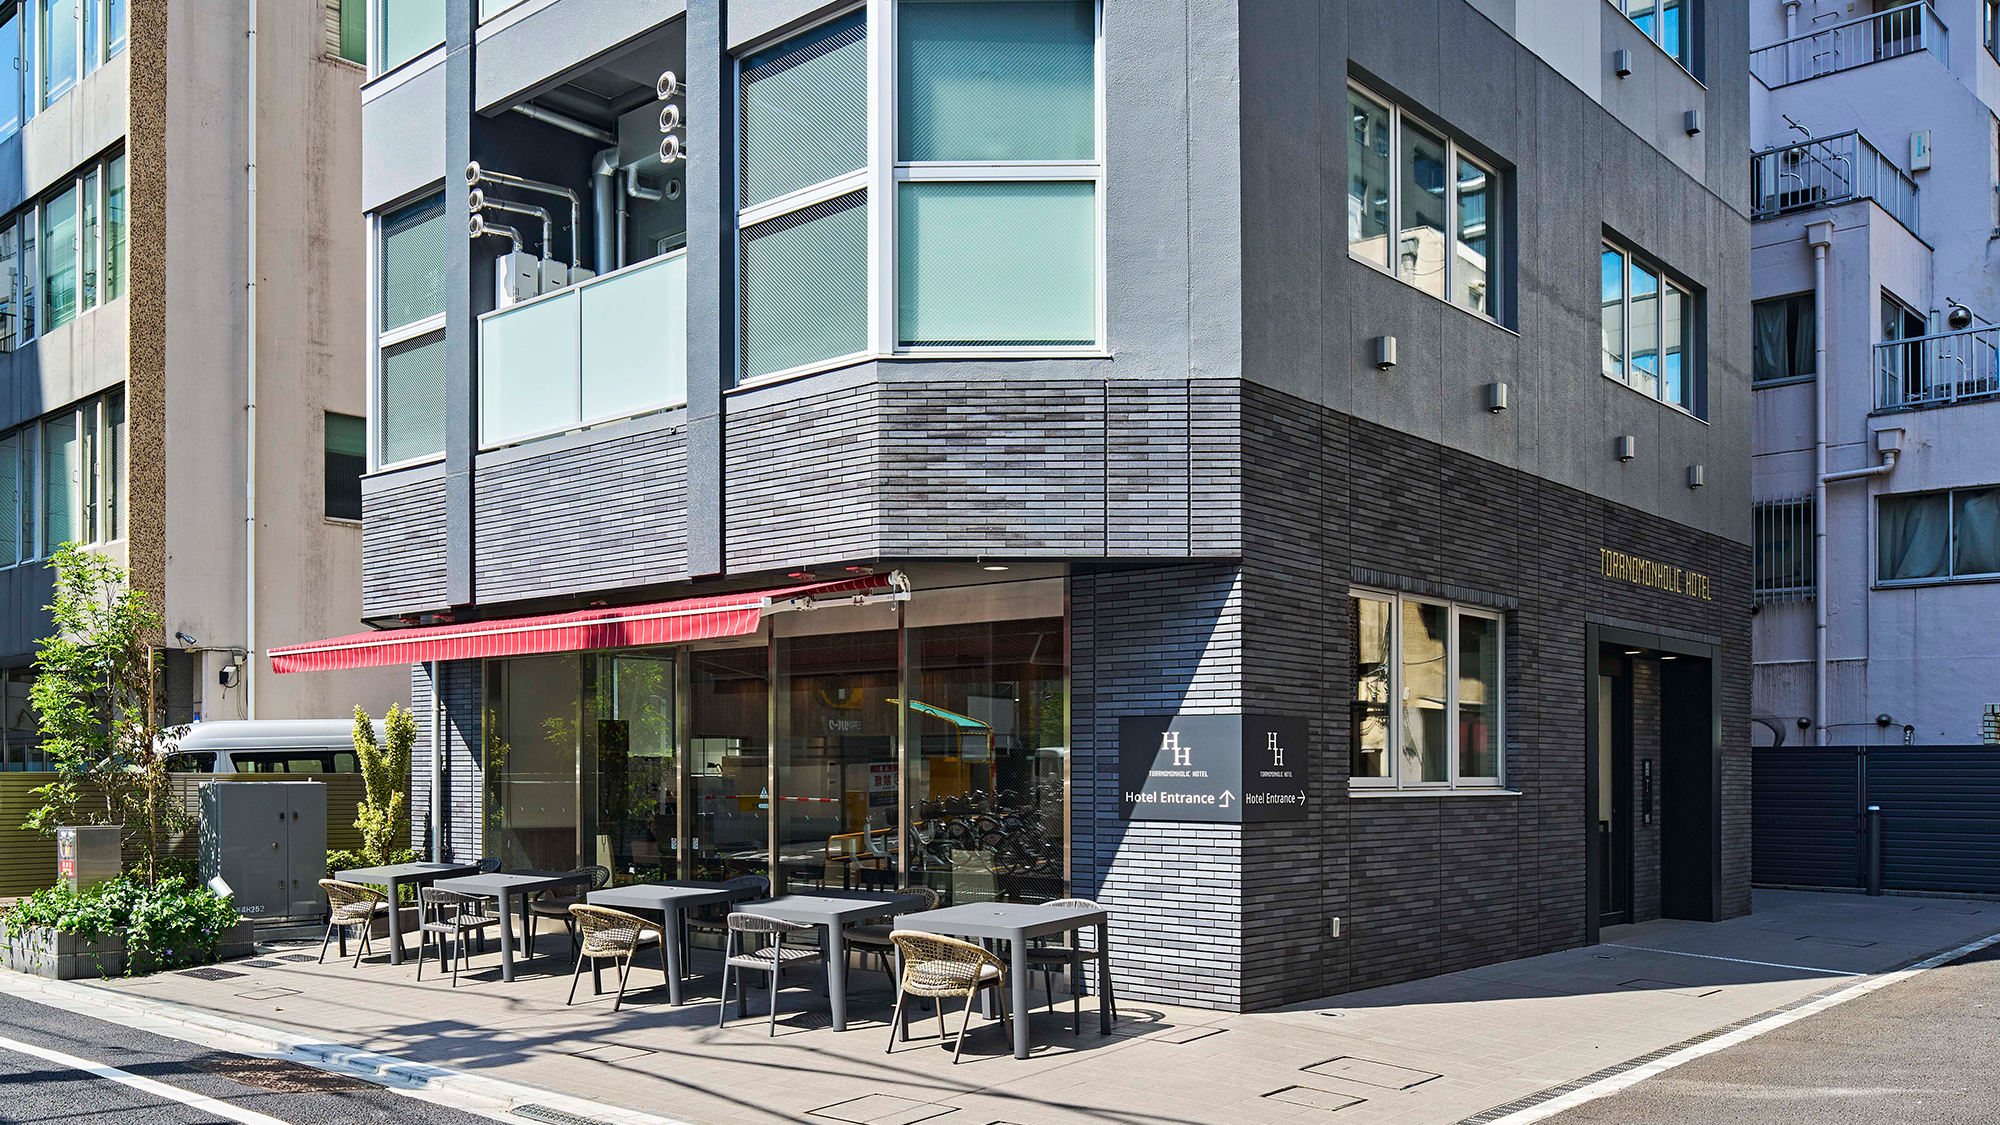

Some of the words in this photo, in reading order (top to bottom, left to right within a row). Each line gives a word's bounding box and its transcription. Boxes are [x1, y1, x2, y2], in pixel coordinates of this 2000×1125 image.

[1600, 548, 1682, 594] TORANOMONHOLIC
[1686, 571, 1712, 601] HOTEL
[1125, 791, 1157, 803] Hotel
[1161, 792, 1215, 804] Entrance
[1245, 792, 1265, 804] Hotel
[1266, 793, 1296, 804] Entrance
